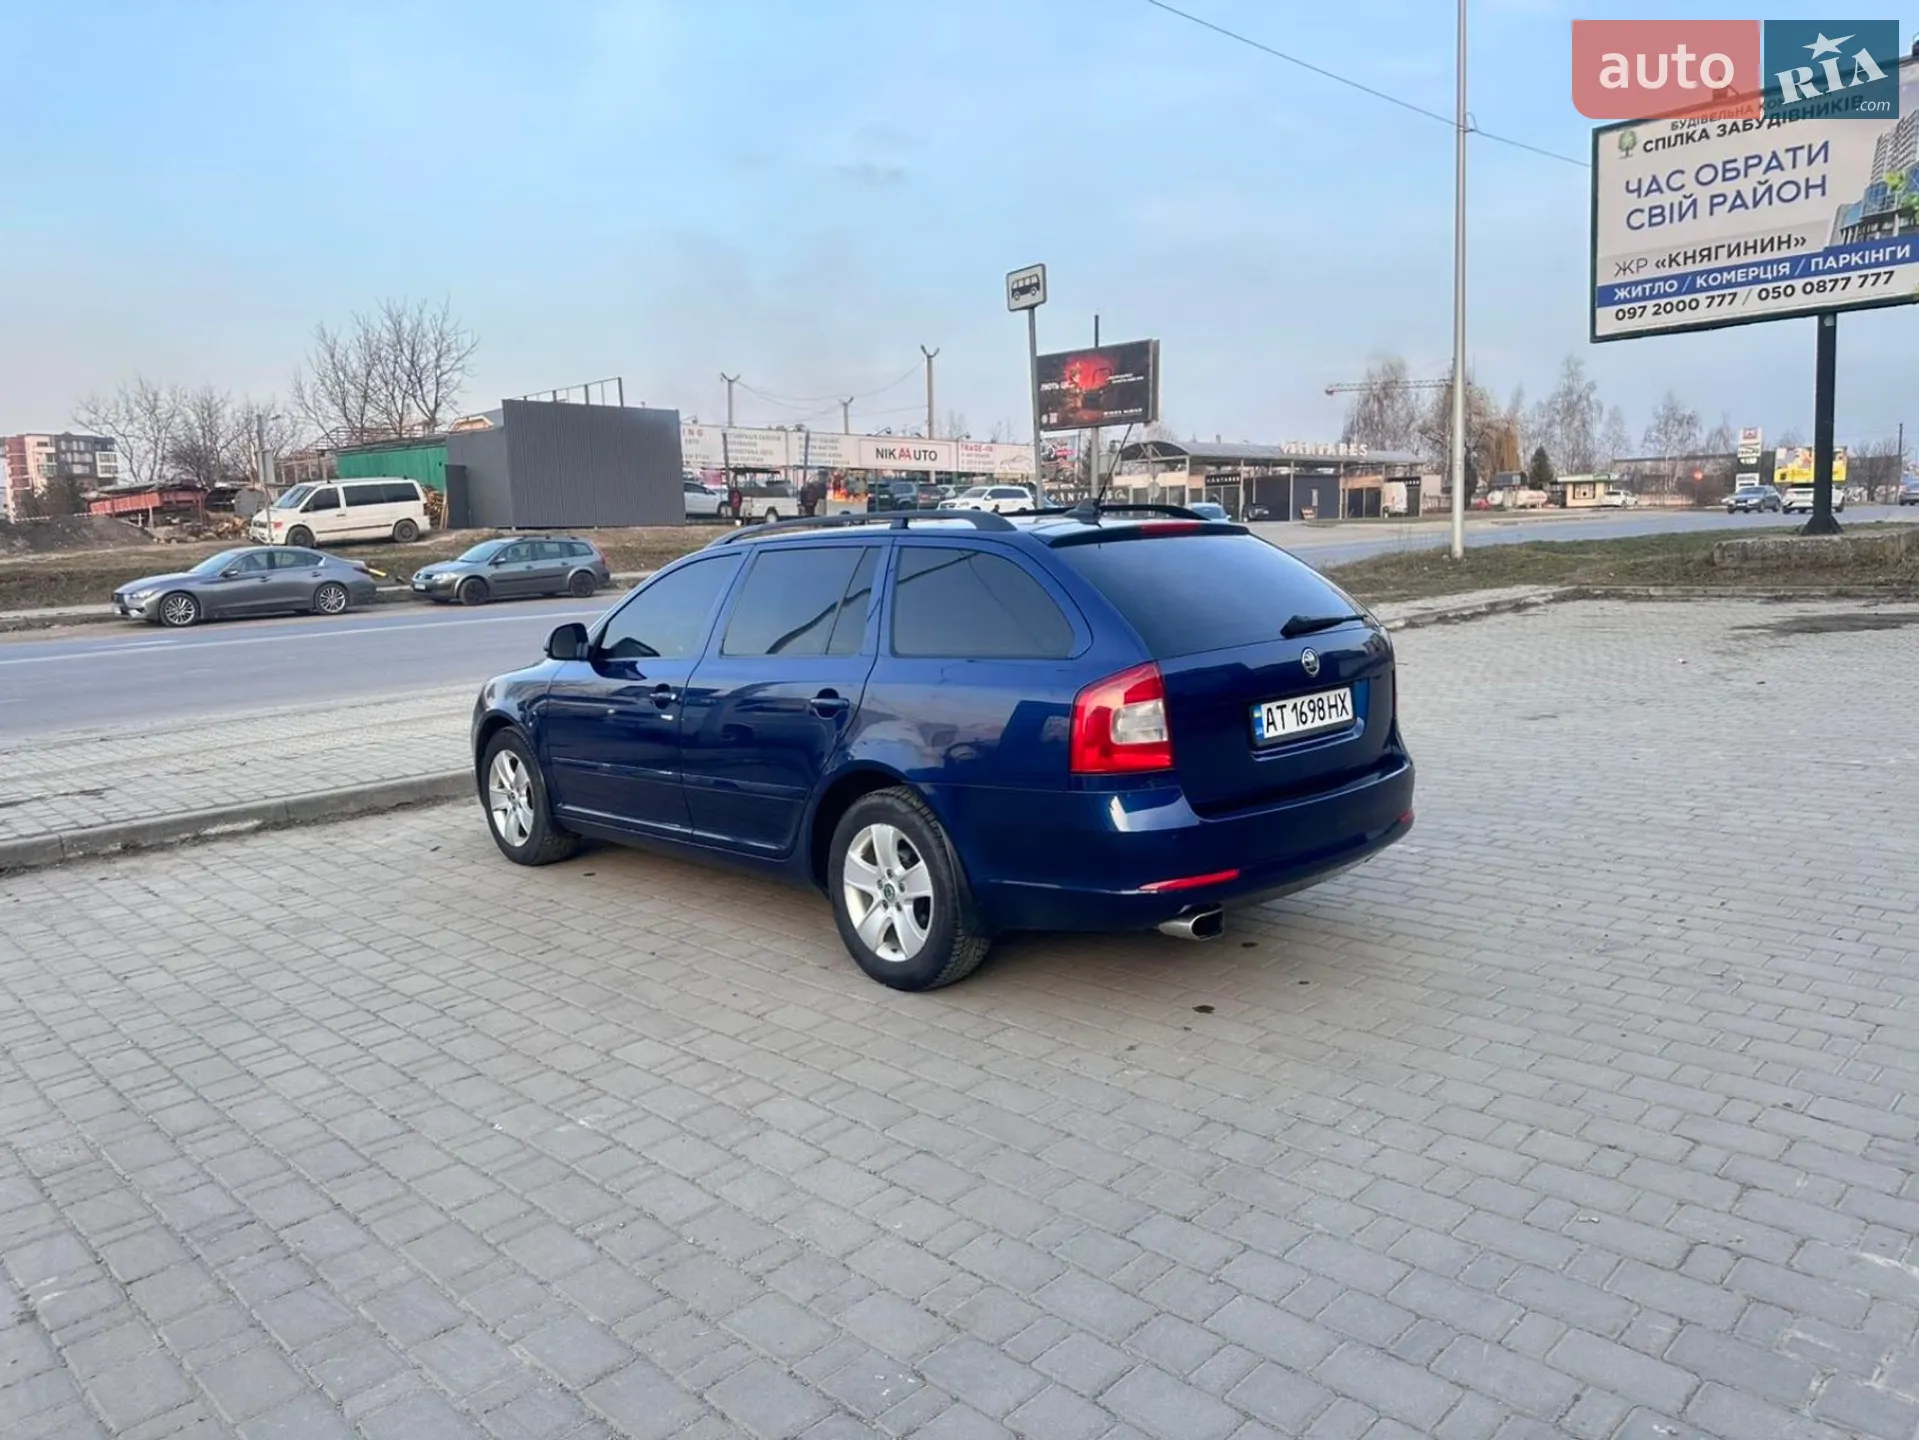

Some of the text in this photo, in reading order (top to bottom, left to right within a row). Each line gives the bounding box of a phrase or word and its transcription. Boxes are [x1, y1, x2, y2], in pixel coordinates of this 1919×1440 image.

[1643, 129, 1710, 153] СПІЛКА
[1625, 140, 1830, 199] ЧАС ОБРАТИ
[1626, 174, 1827, 231] СВІЙ РАЙОН
[1613, 279, 1678, 301] ЖИТЛО
[1695, 262, 1791, 289] КОМЕРЦІЯ
[1810, 244, 1911, 272] ПАРКІНГИ
[1614, 234, 1807, 278] ЖР «КНЯГИНИН»
[1615, 305, 1647, 321] 097
[1652, 297, 1700, 316] 2000
[1704, 291, 1738, 309] 777
[1757, 284, 1796, 301] 050
[1802, 276, 1852, 295] 0877
[1857, 270, 1895, 288] 777
[1291, 697, 1326, 726] 1698
